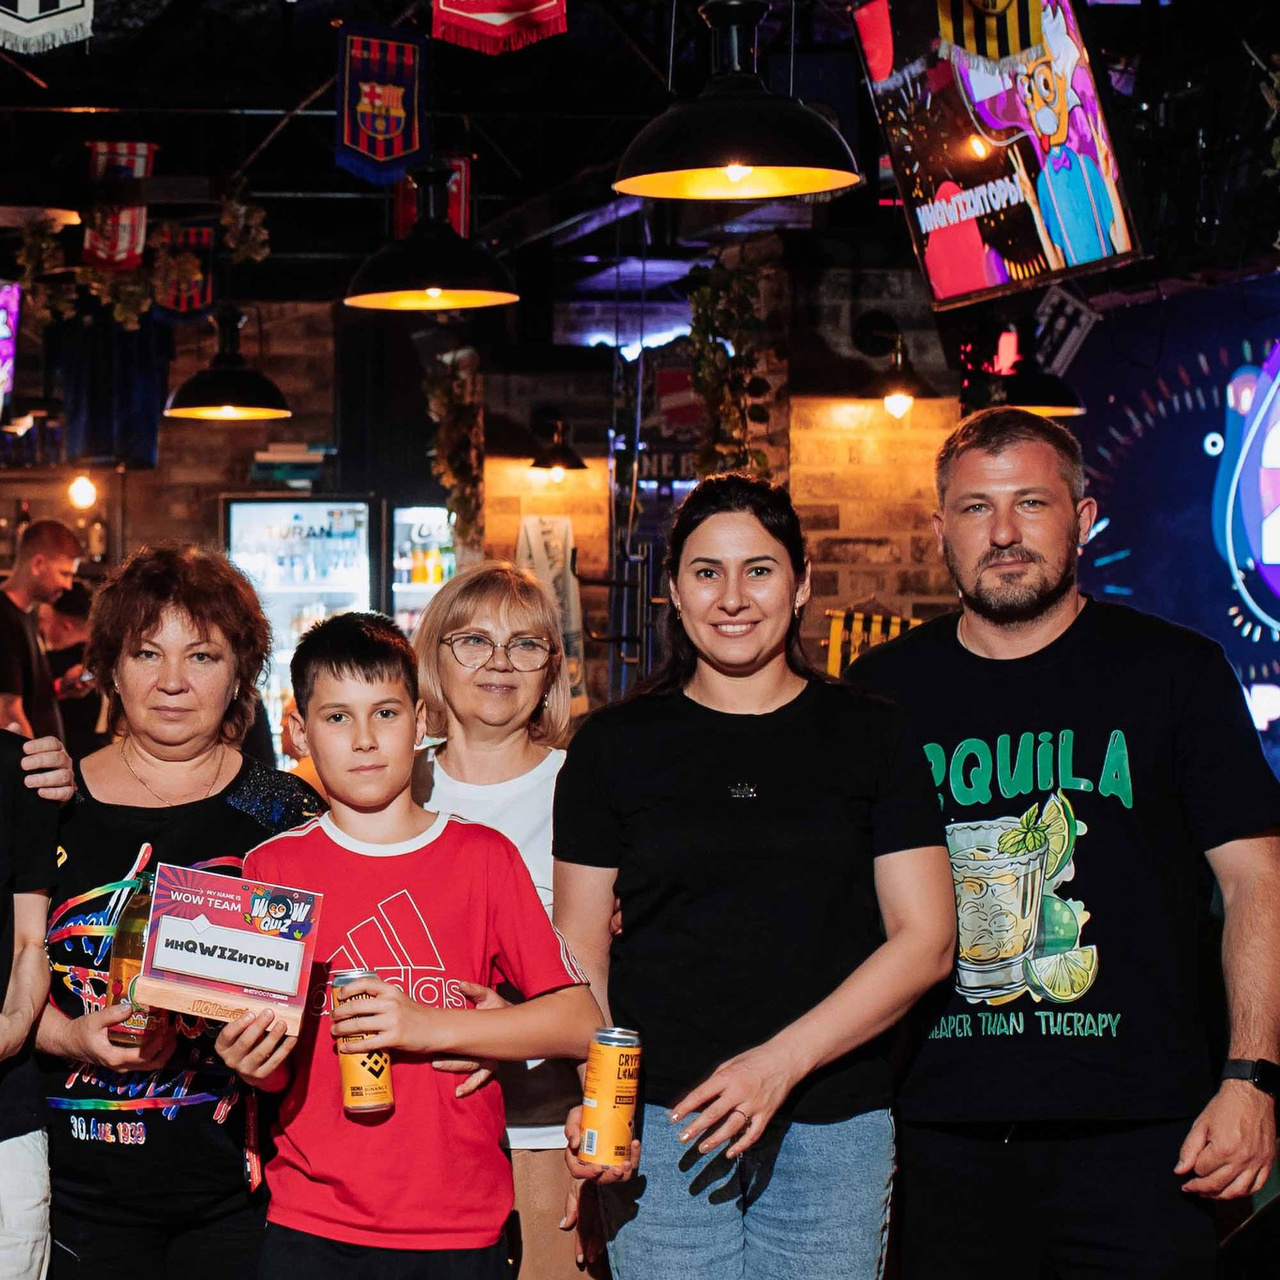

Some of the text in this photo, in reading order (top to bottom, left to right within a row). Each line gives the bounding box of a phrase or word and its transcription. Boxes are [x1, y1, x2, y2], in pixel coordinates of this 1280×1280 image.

[170, 890, 242, 913] WOW TEAM
[217, 891, 235, 900] NAME
[259, 918, 293, 934] QUIZ
[977, 1011, 1024, 1036] THAN
[1034, 1010, 1122, 1037] THERAPY
